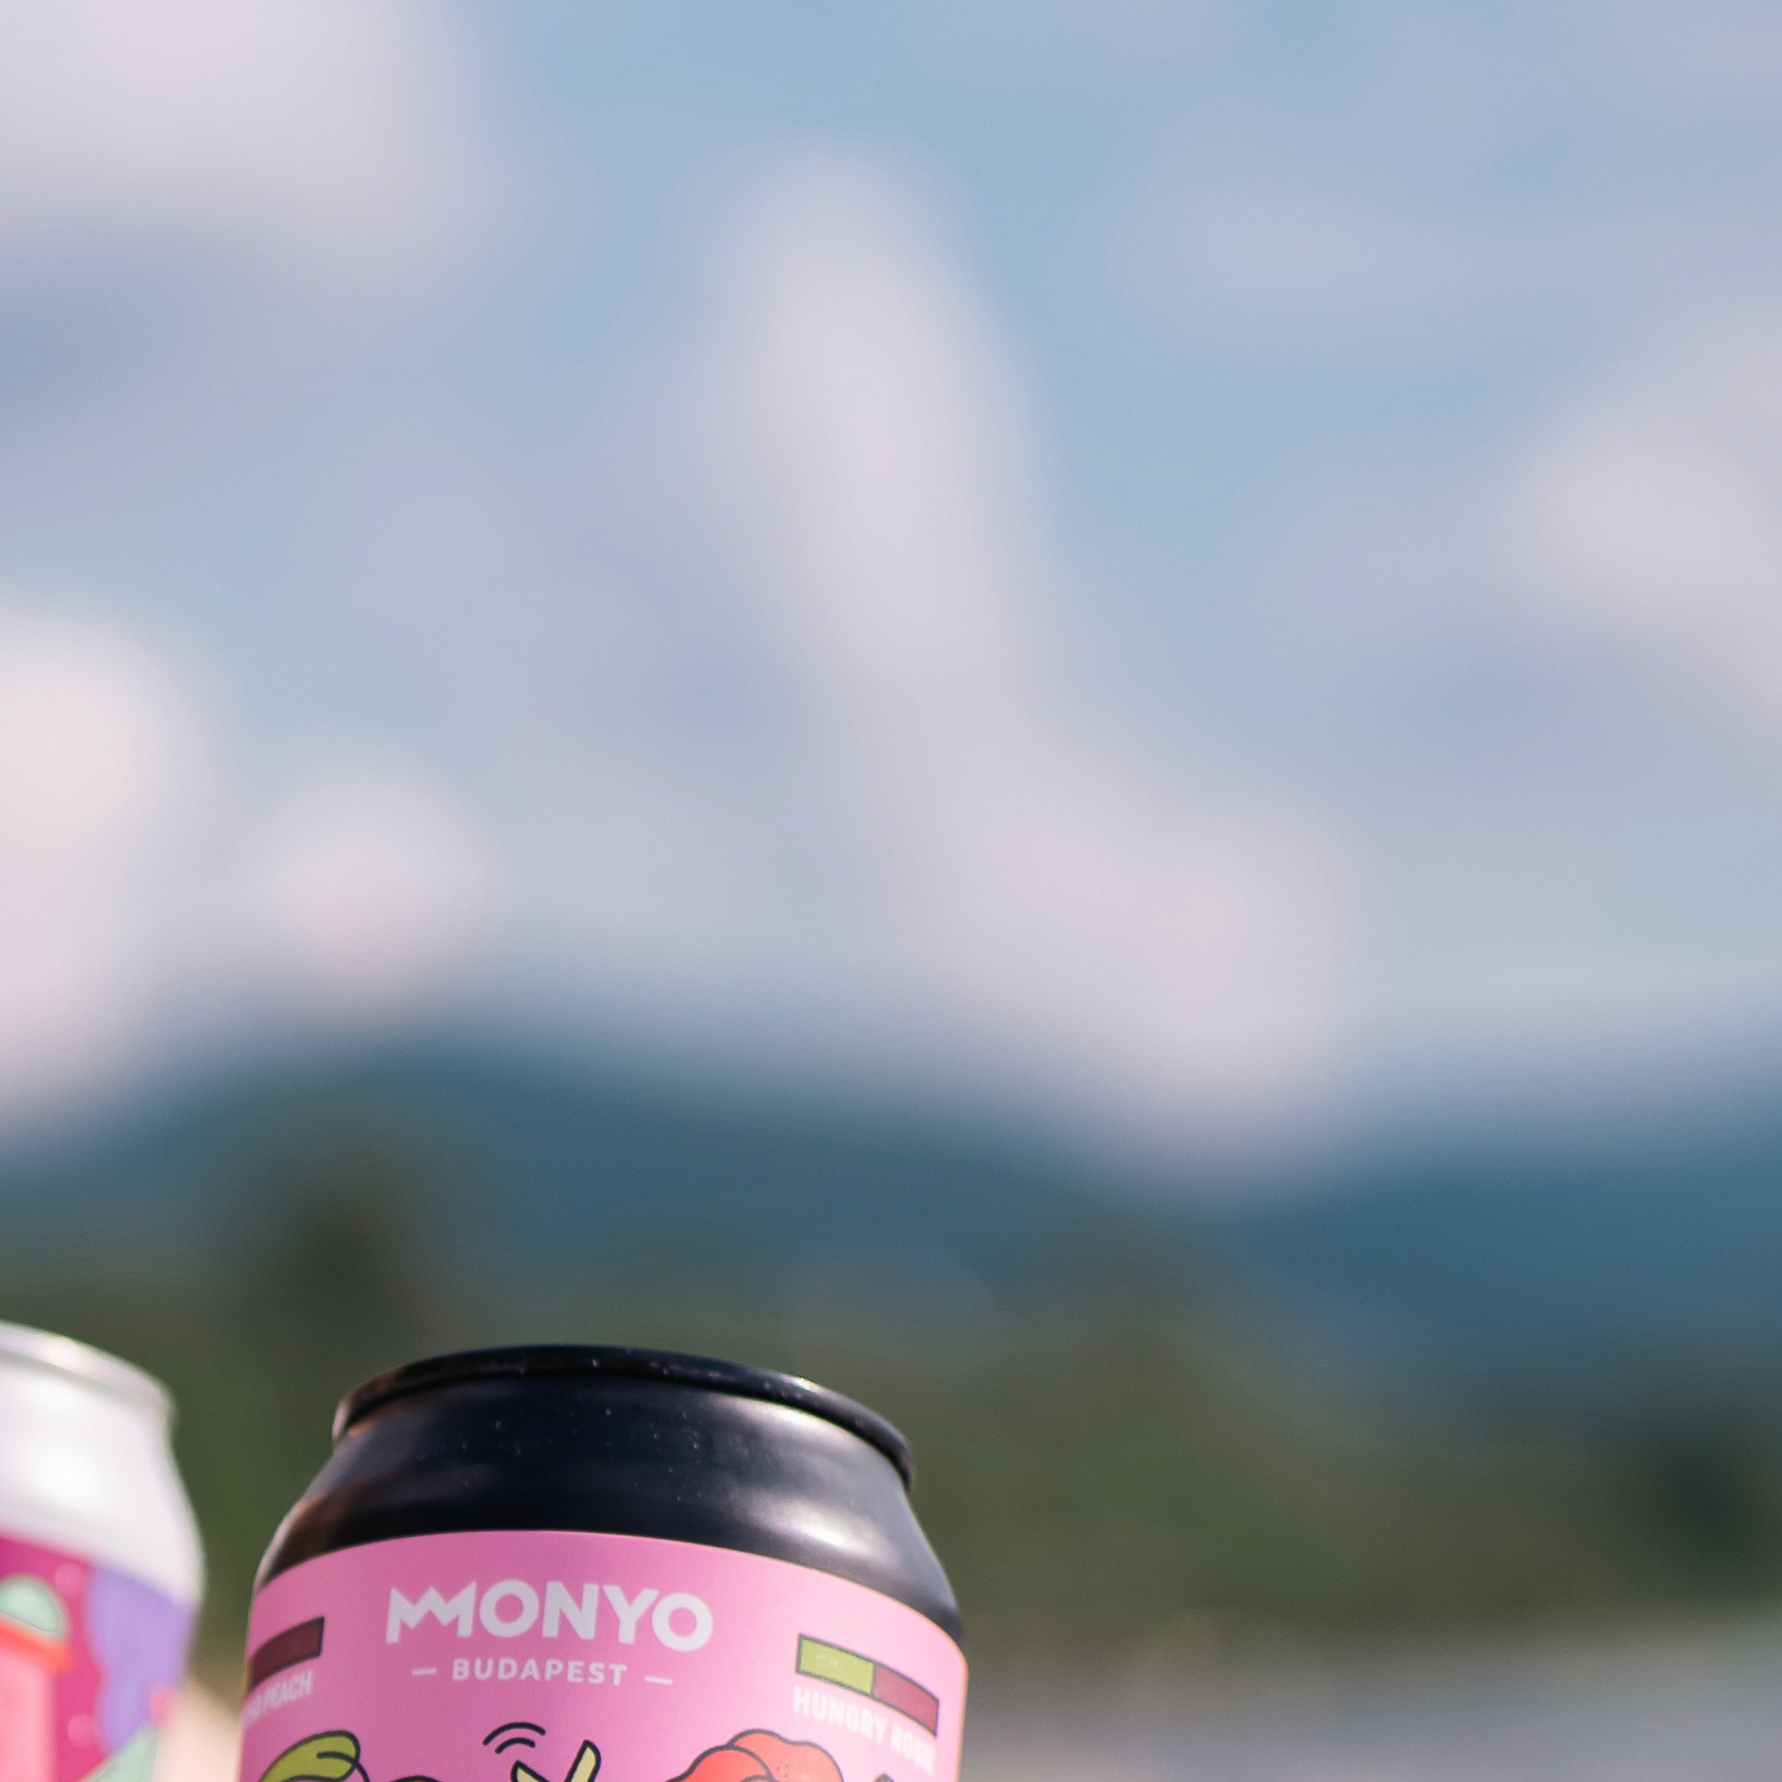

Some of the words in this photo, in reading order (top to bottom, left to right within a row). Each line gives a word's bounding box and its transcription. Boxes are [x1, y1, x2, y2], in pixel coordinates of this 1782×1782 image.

[385, 1579, 713, 1653] MONYO
[452, 1657, 627, 1686] BUDAPEST
[792, 1685, 888, 1744] HUNGRY
